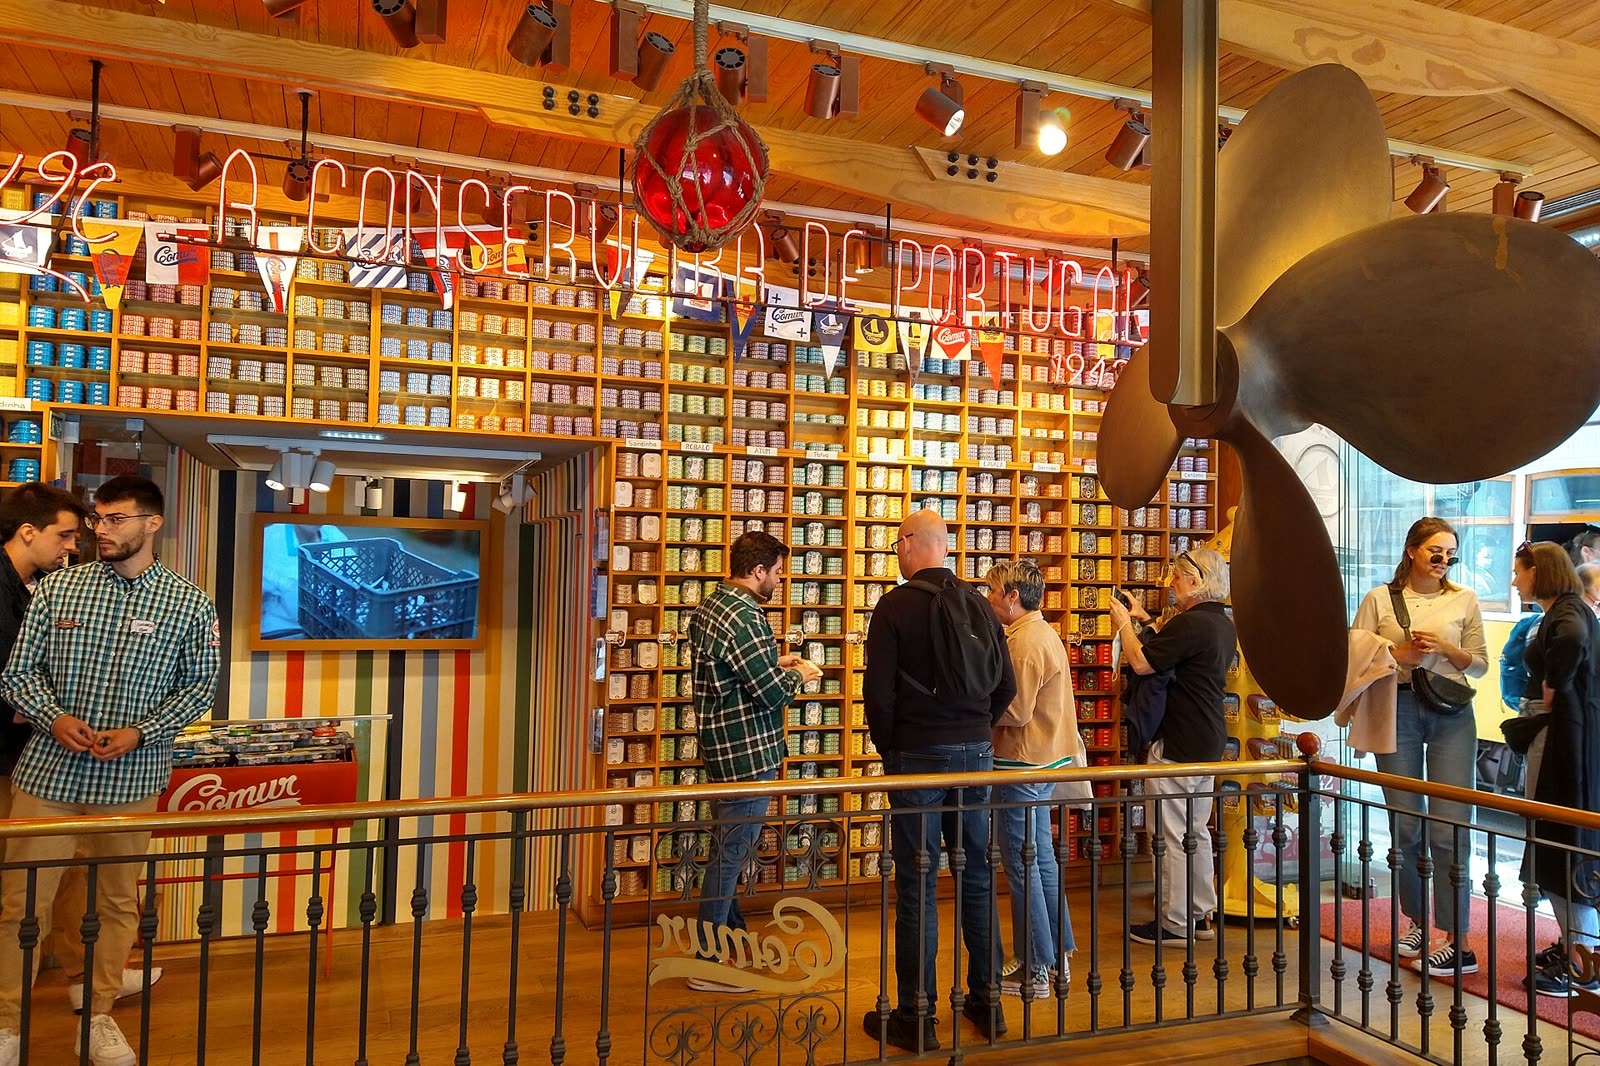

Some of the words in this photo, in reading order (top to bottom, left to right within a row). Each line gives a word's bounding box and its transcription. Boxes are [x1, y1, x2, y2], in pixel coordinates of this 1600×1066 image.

[154, 245, 199, 266] Comur
[217, 148, 258, 248] A
[803, 221, 864, 313] DE
[894, 237, 1147, 346] PORTUGAL
[771, 308, 805, 323] Comur
[937, 327, 966, 345] Comur
[685, 443, 710, 451] ROBALO
[753, 447, 771, 455] ATUM
[167, 773, 303, 813] Comur
